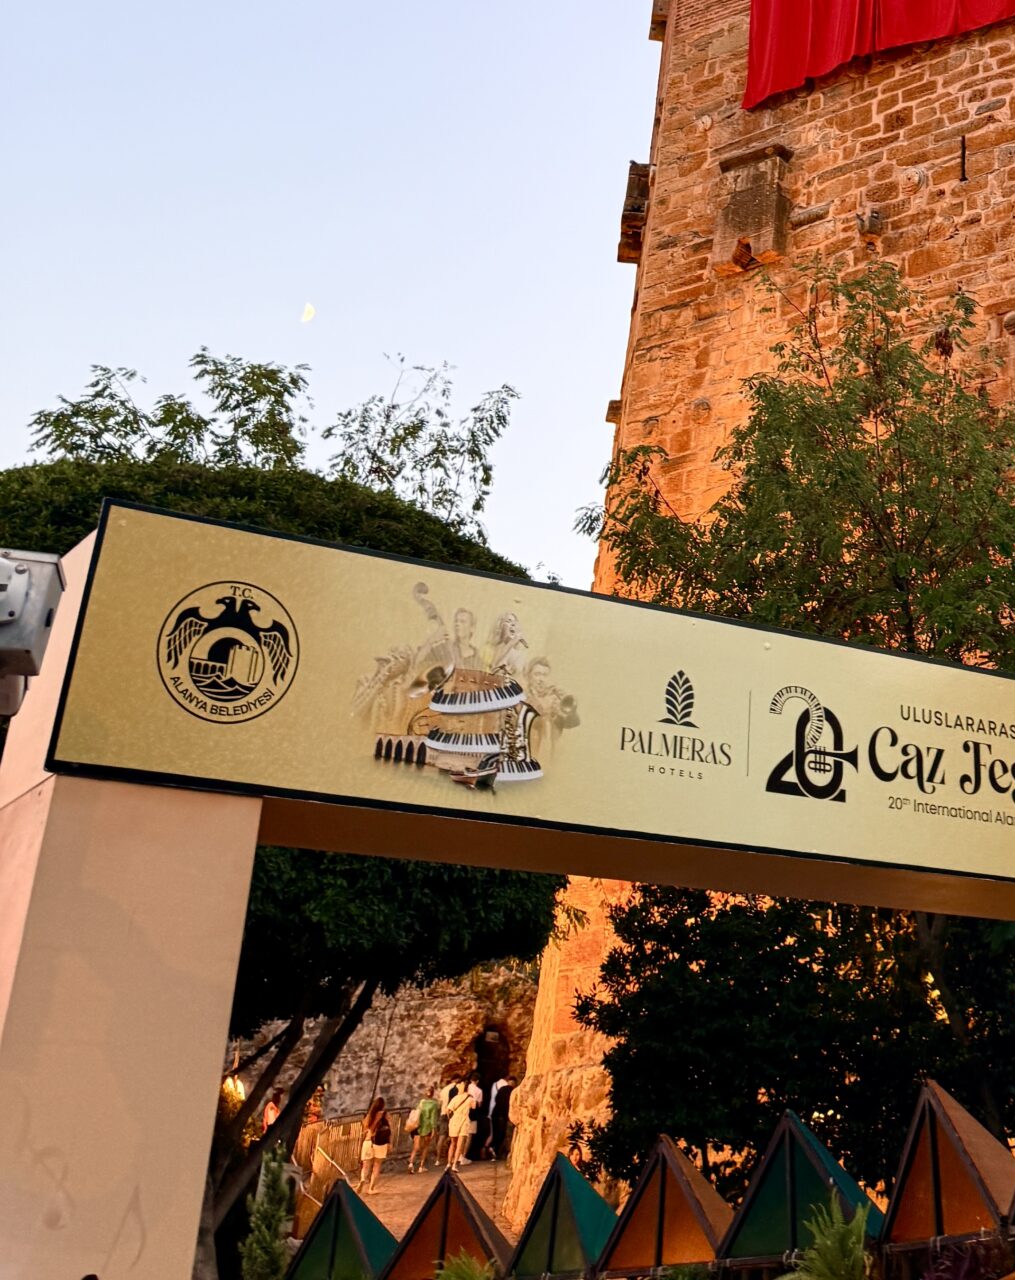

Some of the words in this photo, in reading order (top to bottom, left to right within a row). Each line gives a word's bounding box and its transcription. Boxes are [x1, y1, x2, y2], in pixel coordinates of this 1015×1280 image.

[230, 585, 254, 600] T.C.
[170, 675, 208, 713] ALANYA
[209, 687, 275, 717] BELEDİYESİ
[619, 726, 732, 767] PALMERAS
[868, 726, 946, 795] Caz
[648, 764, 703, 780] HOTELS
[913, 799, 993, 822] International
